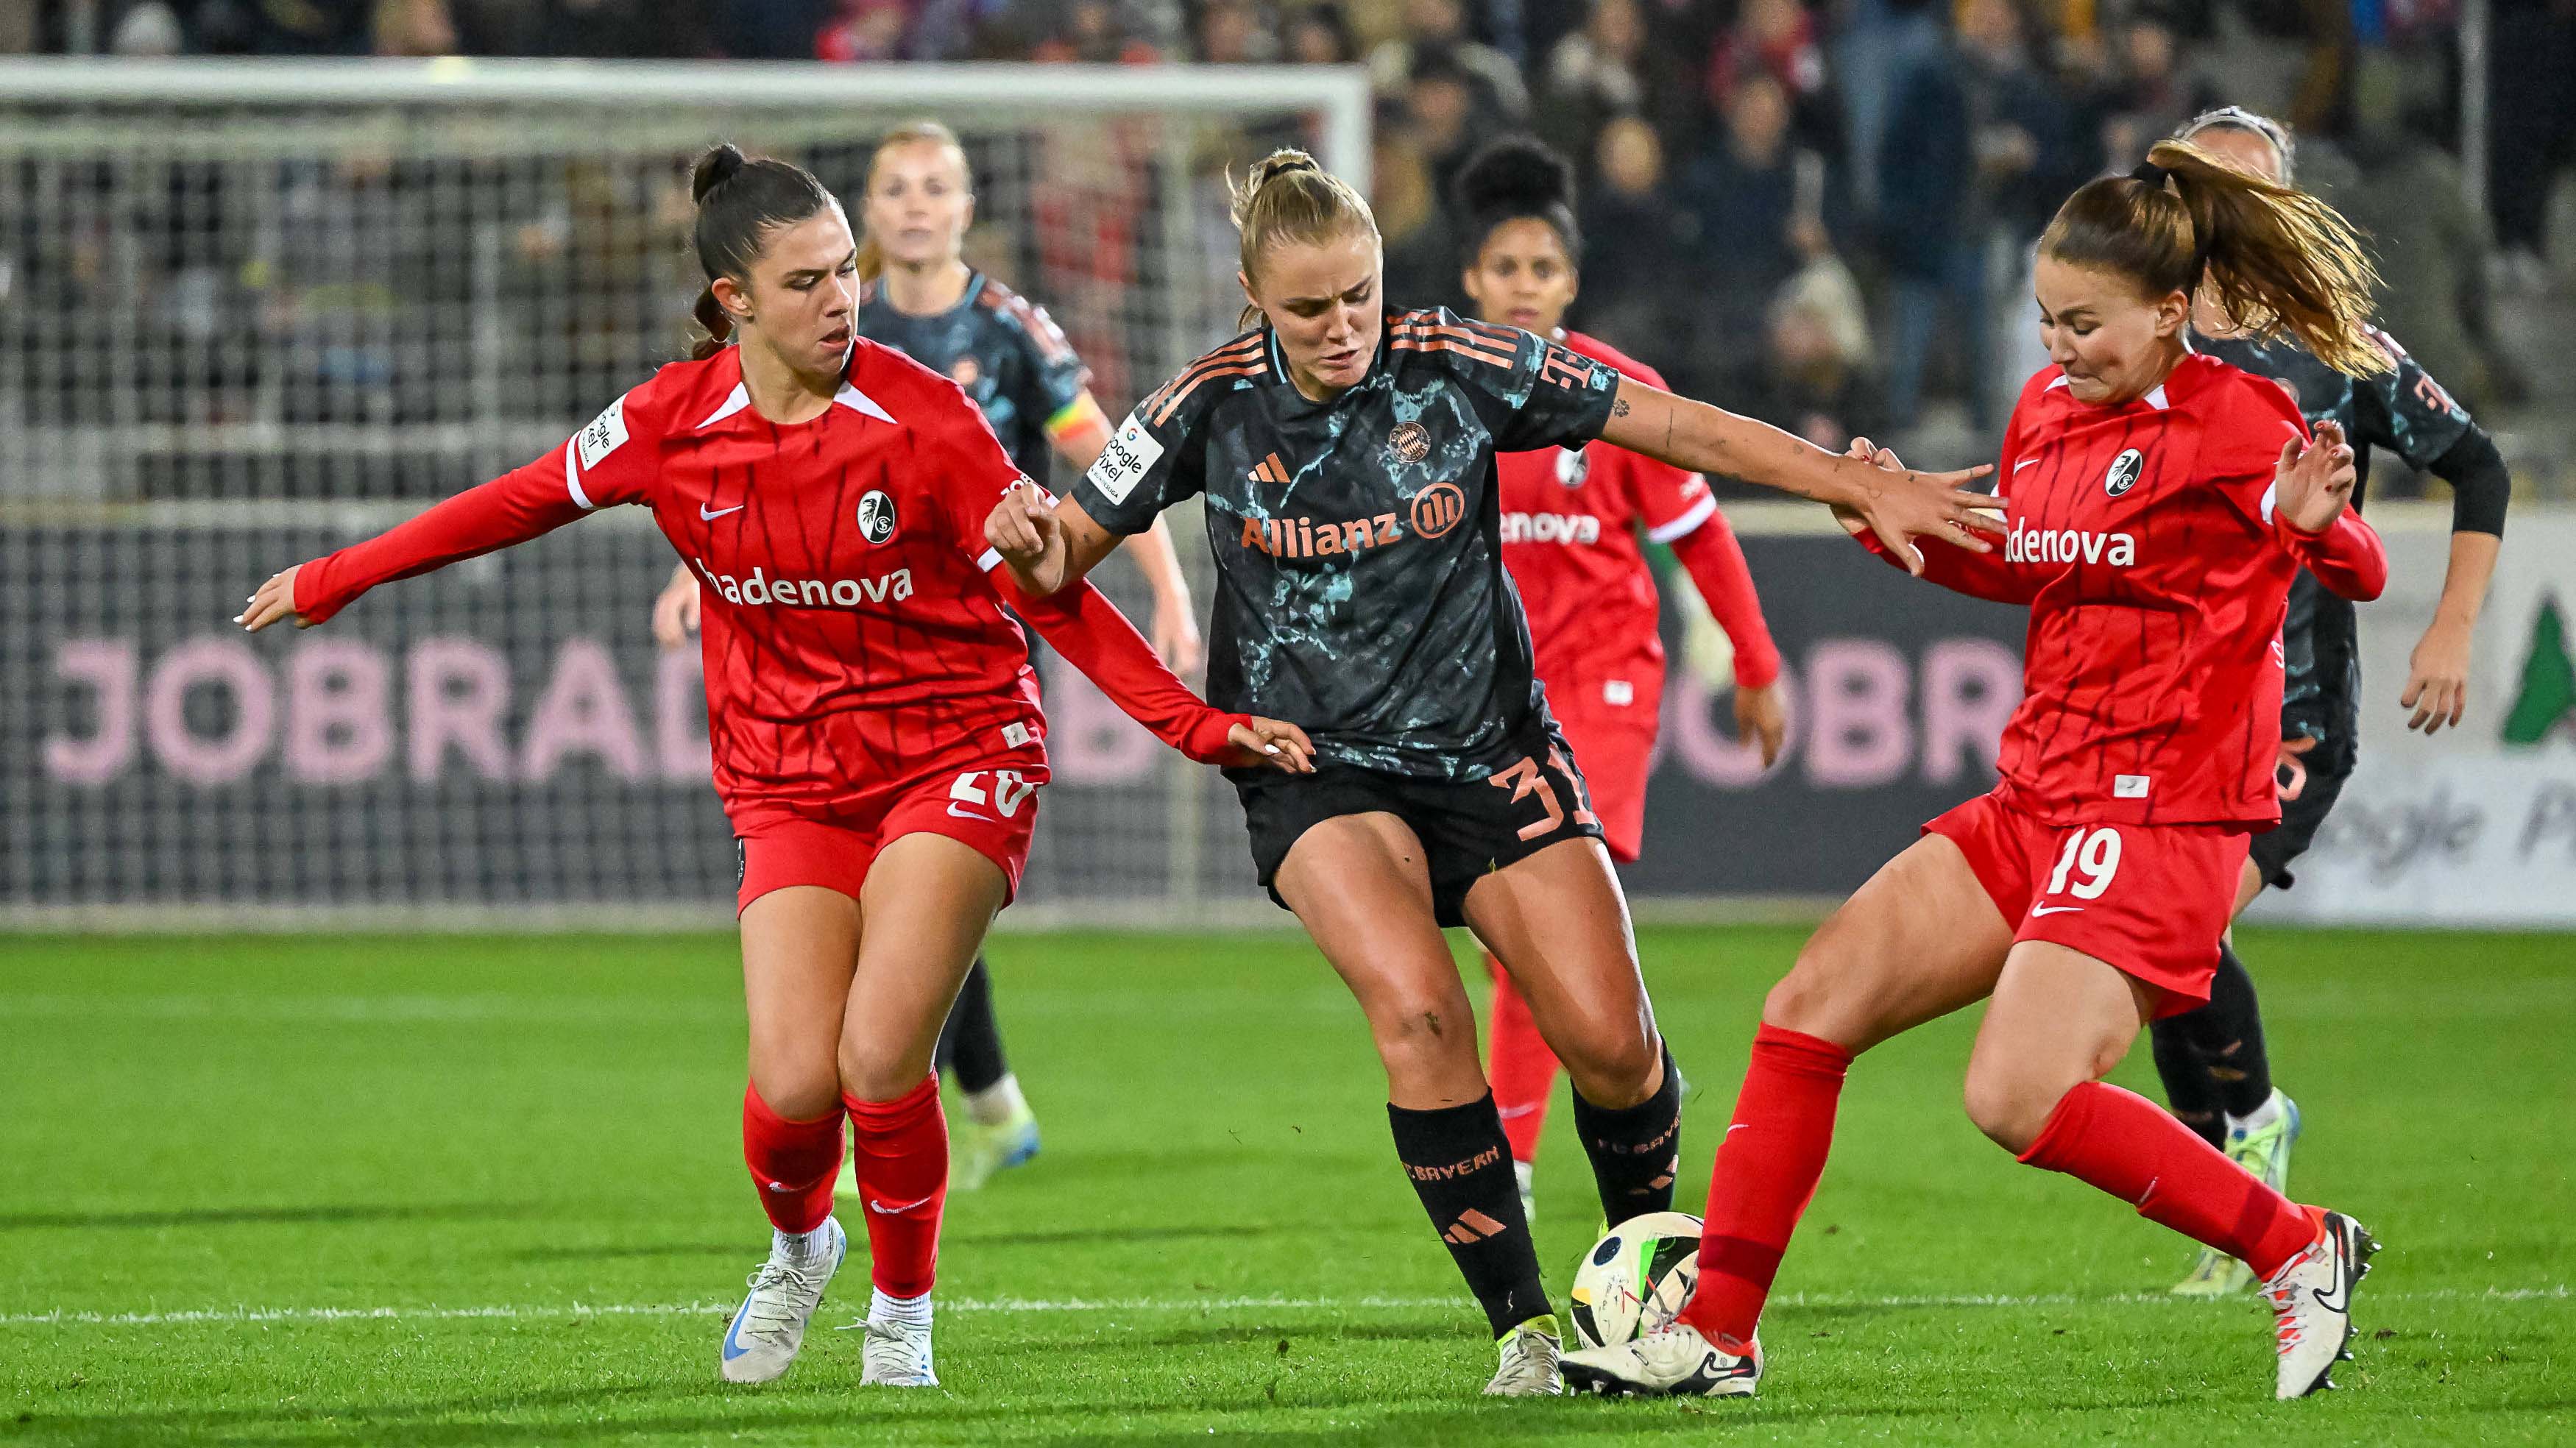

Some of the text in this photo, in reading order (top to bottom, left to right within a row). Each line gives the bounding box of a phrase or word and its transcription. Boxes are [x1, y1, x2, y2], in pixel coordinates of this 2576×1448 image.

[1540, 347, 1592, 388] T
[597, 409, 609, 449] ogle
[1108, 438, 1142, 474] oogle
[1241, 513, 1402, 558] Allianz
[1650, 639, 2030, 783] OBR
[1488, 743, 1599, 842] 31
[2046, 827, 2122, 900] 19
